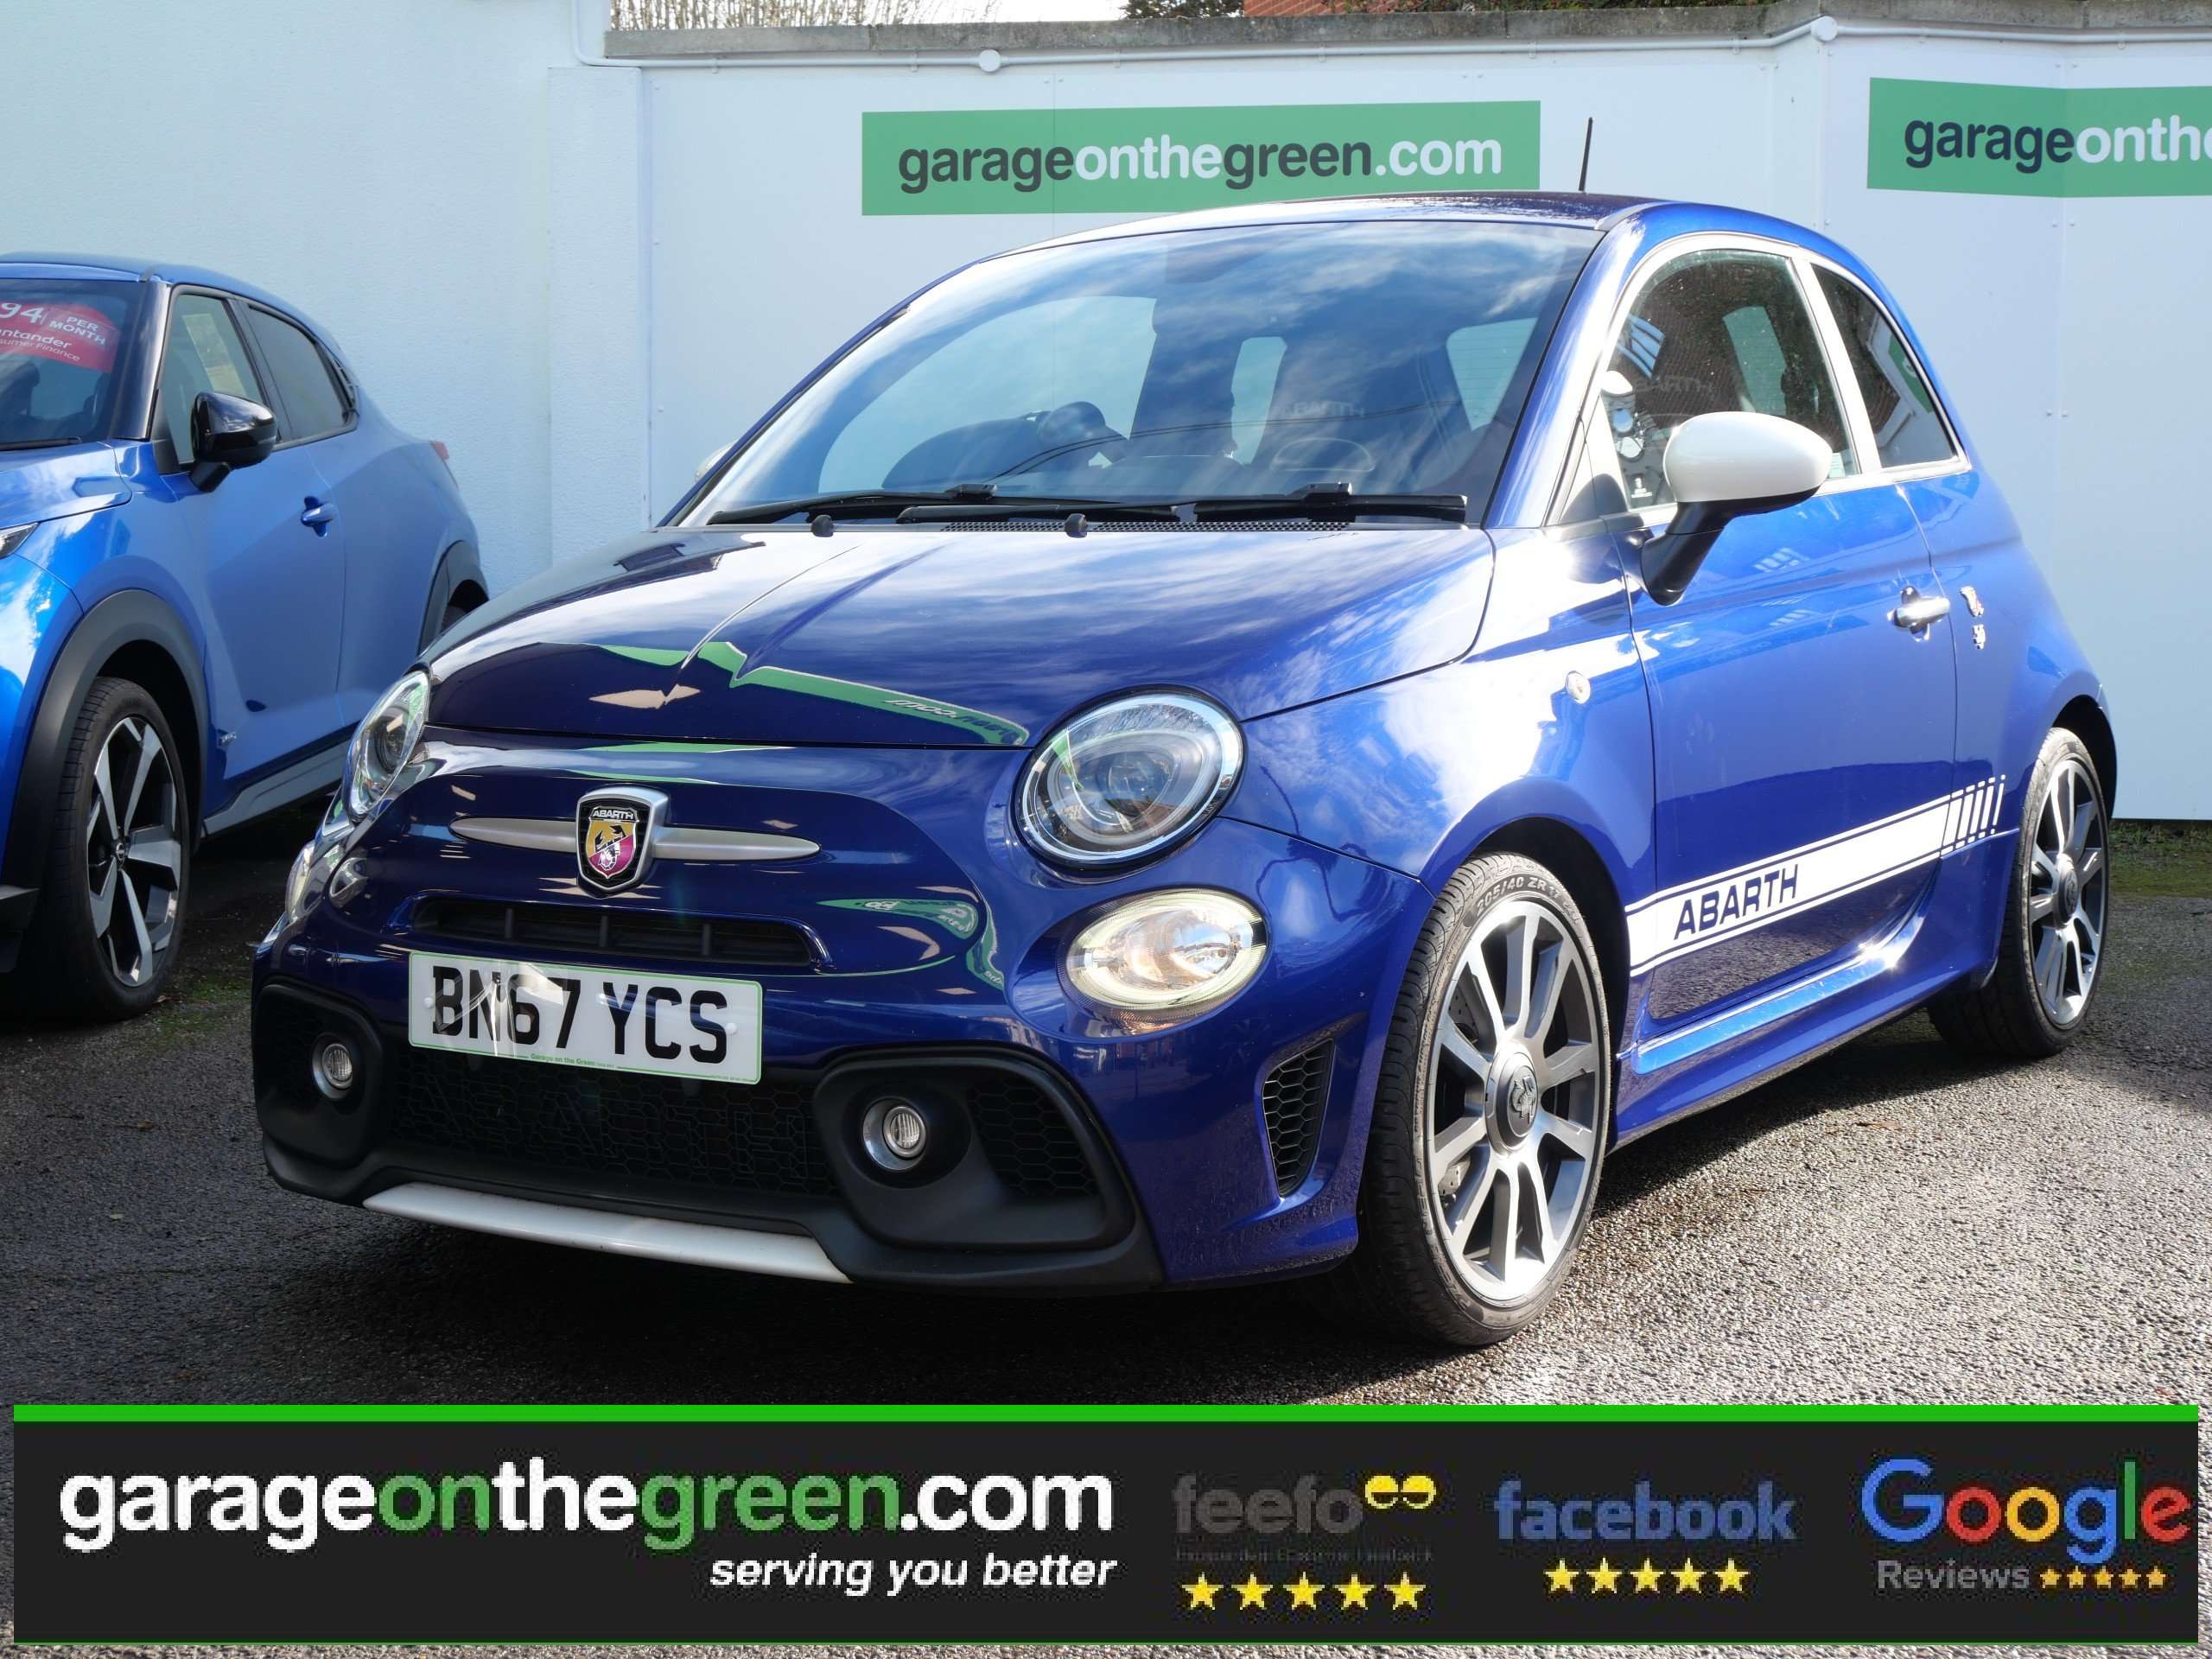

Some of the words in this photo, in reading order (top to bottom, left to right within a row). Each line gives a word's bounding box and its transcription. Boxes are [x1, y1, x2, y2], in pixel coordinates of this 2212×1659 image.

[1904, 114, 2212, 174] garageonth
[898, 134, 1502, 194] garageonthegreen.com
[49, 321, 105, 345] MONTH
[67, 316, 99, 332] PER
[0, 328, 72, 349] ntander
[35, 343, 80, 362] Finance
[592, 810, 634, 819] ABARTH
[1477, 876, 1524, 918] 205/40
[1674, 864, 1798, 940] ABARTH
[432, 965, 581, 1049] BN67
[603, 982, 728, 1065] YCS
[531, 1053, 553, 1063] Garage
[576, 1058, 595, 1066] Green
